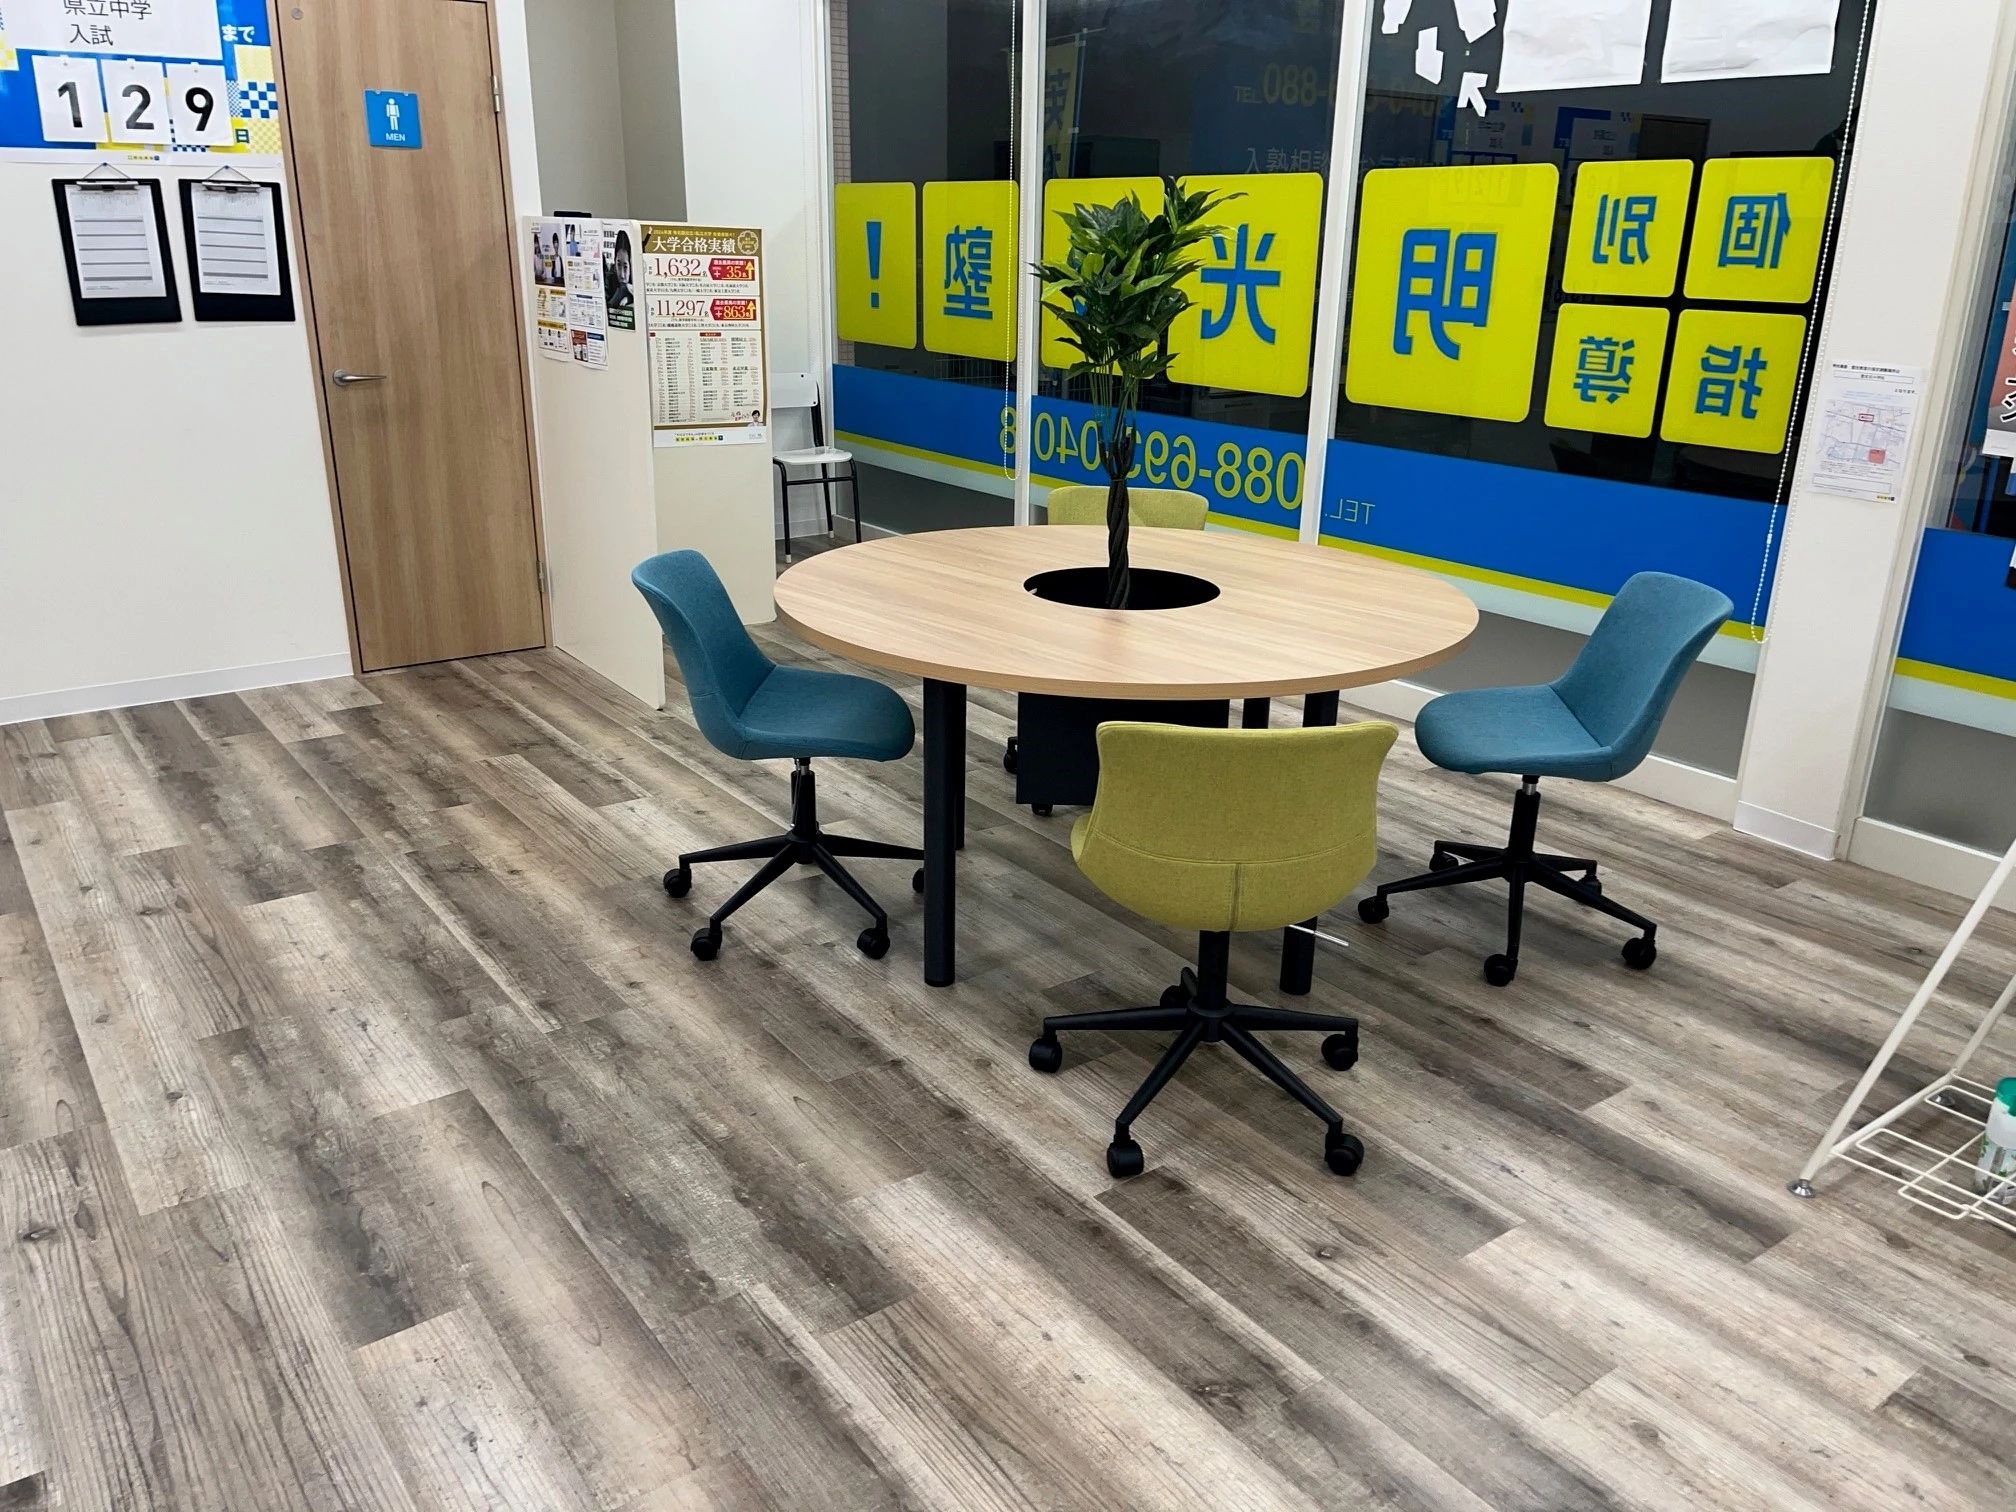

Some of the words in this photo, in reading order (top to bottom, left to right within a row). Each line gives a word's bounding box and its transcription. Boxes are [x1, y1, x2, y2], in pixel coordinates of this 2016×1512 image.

[64, 0, 152, 20] 県立中学
[70, 24, 114, 46] 入試
[222, 25, 255, 42] まで
[235, 128, 250, 143] 日
[385, 133, 405, 141] MEN
[652, 235, 736, 254] 大学合格実績
